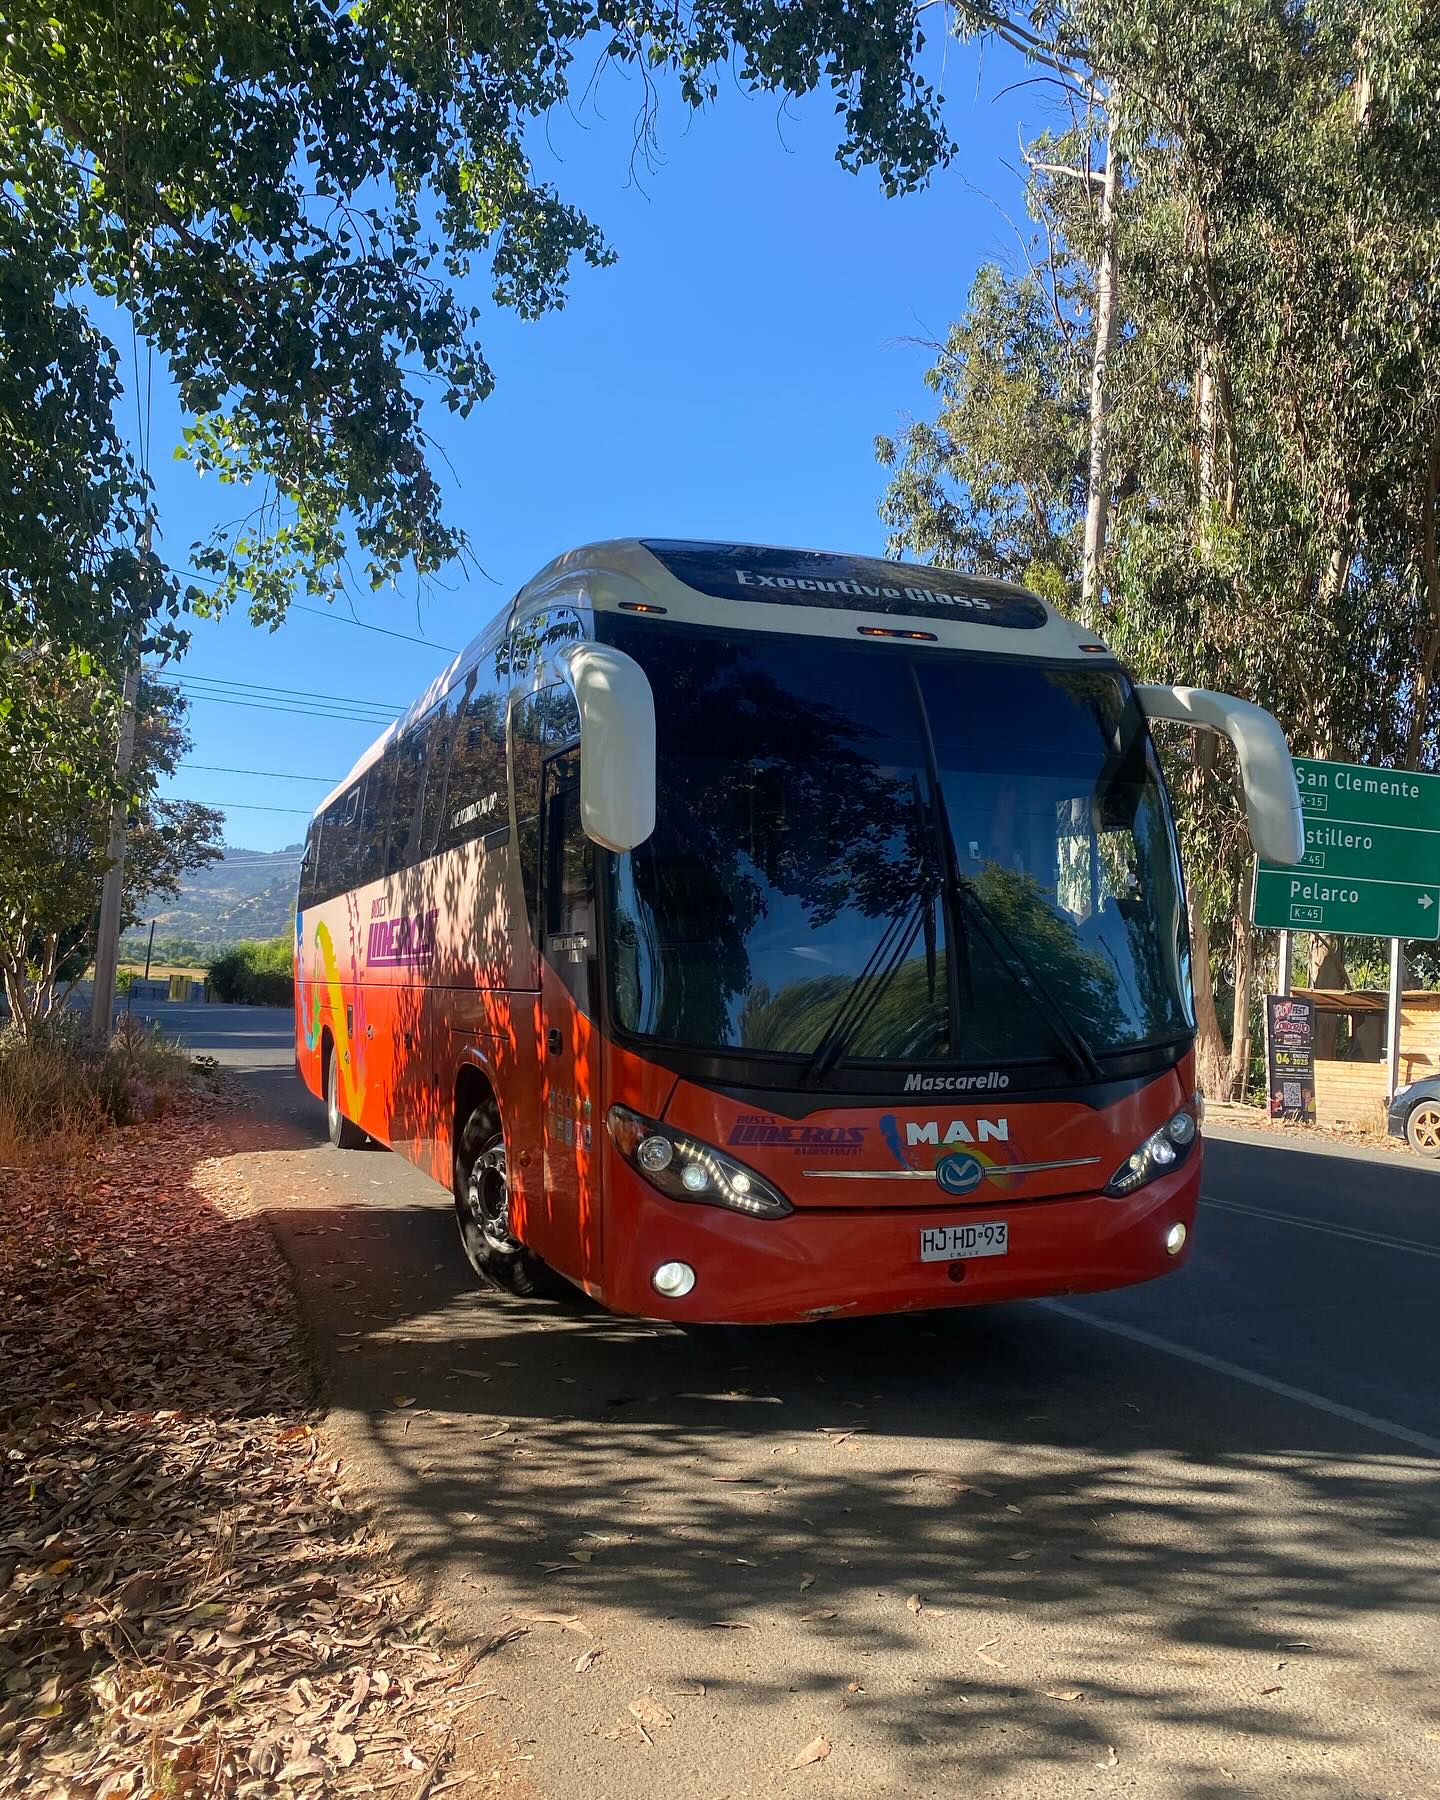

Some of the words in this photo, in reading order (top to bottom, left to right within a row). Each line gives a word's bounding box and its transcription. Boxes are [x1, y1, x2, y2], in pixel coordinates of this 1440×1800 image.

[735, 570, 901, 599] Executive
[1295, 767, 1328, 787] San
[1335, 773, 1420, 798] Clemente
[1300, 795, 1323, 807] K-15
[1306, 828, 1373, 849] stillero
[1290, 881, 1359, 903] Pelarco
[1294, 908, 1318, 919] K-45
[1275, 1052, 1290, 1065] 04
[904, 1072, 1009, 1091] Mascarello
[905, 1119, 1009, 1146] MAN
